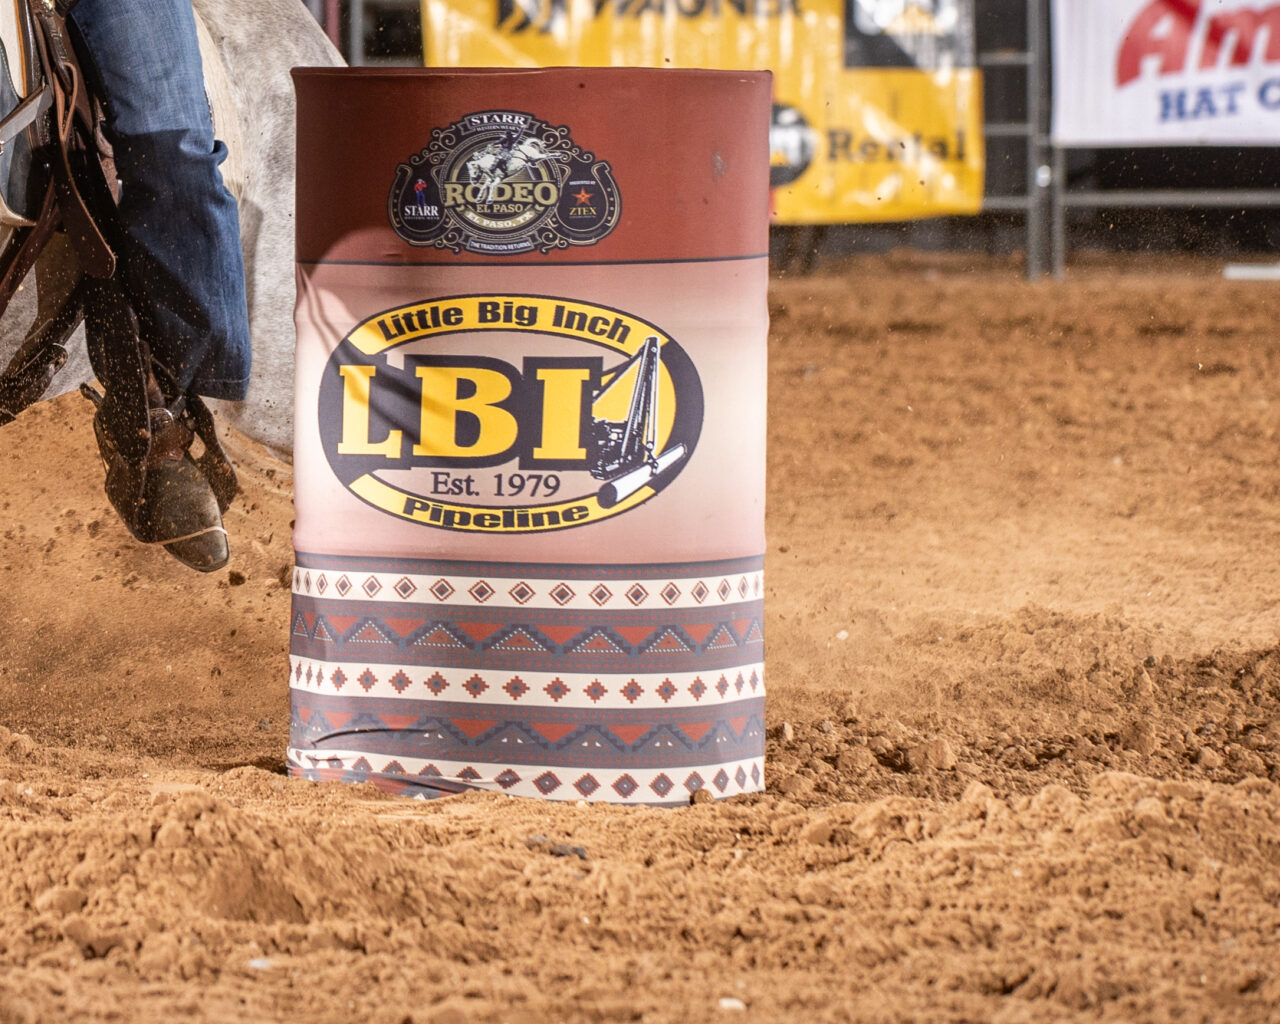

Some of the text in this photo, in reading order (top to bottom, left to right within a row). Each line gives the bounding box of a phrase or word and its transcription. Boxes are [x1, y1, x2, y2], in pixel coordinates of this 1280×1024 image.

[1159, 83, 1245, 122] HAT
[471, 114, 526, 125] STARR
[444, 182, 559, 207] RODEO
[404, 205, 439, 216] STARR
[466, 211, 480, 224] EL
[519, 210, 534, 223] TX
[477, 204, 523, 213] EL PASO
[376, 301, 631, 345] Little Big Inch
[337, 365, 590, 460] LBI
[430, 472, 561, 498] Est. 1979
[403, 496, 590, 530] Pipeline
